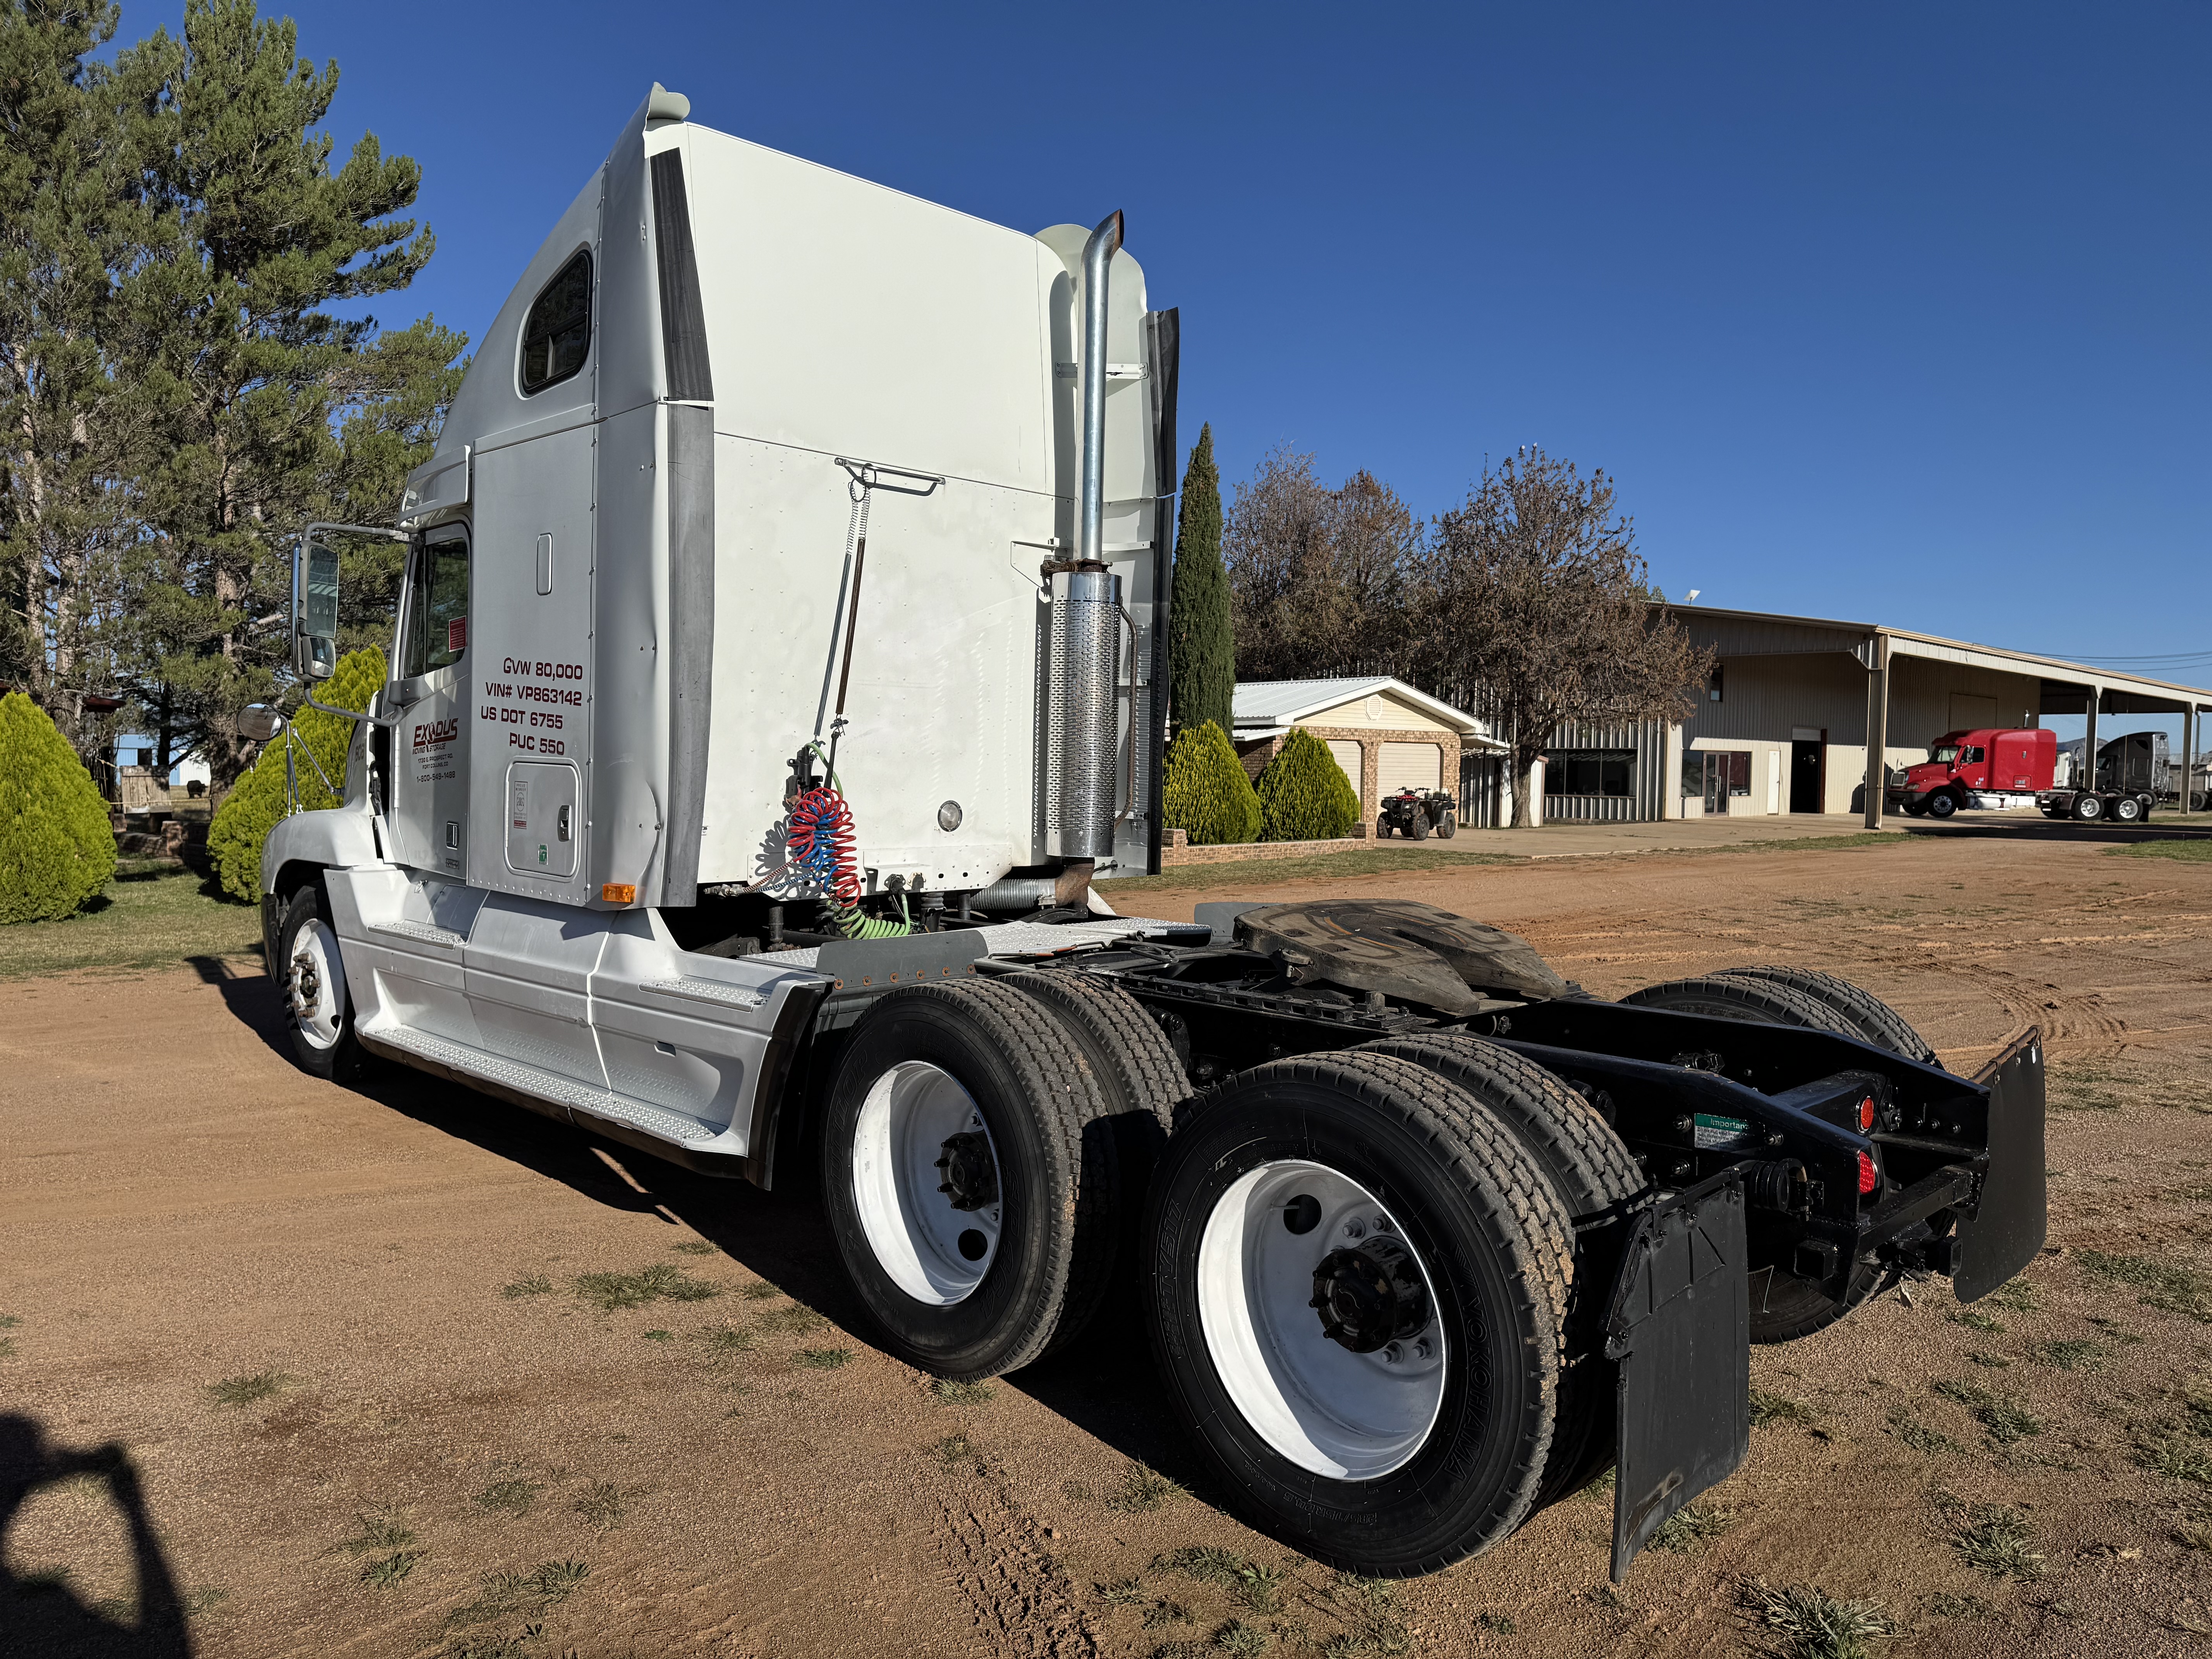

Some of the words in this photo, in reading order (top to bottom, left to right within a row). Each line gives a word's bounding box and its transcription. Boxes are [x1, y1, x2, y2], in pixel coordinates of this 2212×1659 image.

[503, 657, 531, 675] GVW
[536, 662, 583, 681] 80,000
[485, 682, 512, 698] VIN#
[517, 685, 582, 706] VP863142
[481, 705, 496, 721] US
[501, 708, 526, 725] DOT
[530, 712, 563, 729] 6755
[413, 718, 459, 748] EXODUS
[509, 732, 535, 750] PUC
[539, 738, 565, 756] 550
[412, 746, 425, 755] MOVING
[429, 743, 446, 752] STORAGE
[429, 754, 447, 762] PROSPECT
[417, 771, 456, 783] 1-800-549-1488
[1159, 1198, 1182, 1296] TY517
[1444, 1295, 1492, 1482] YOKOHAMA
